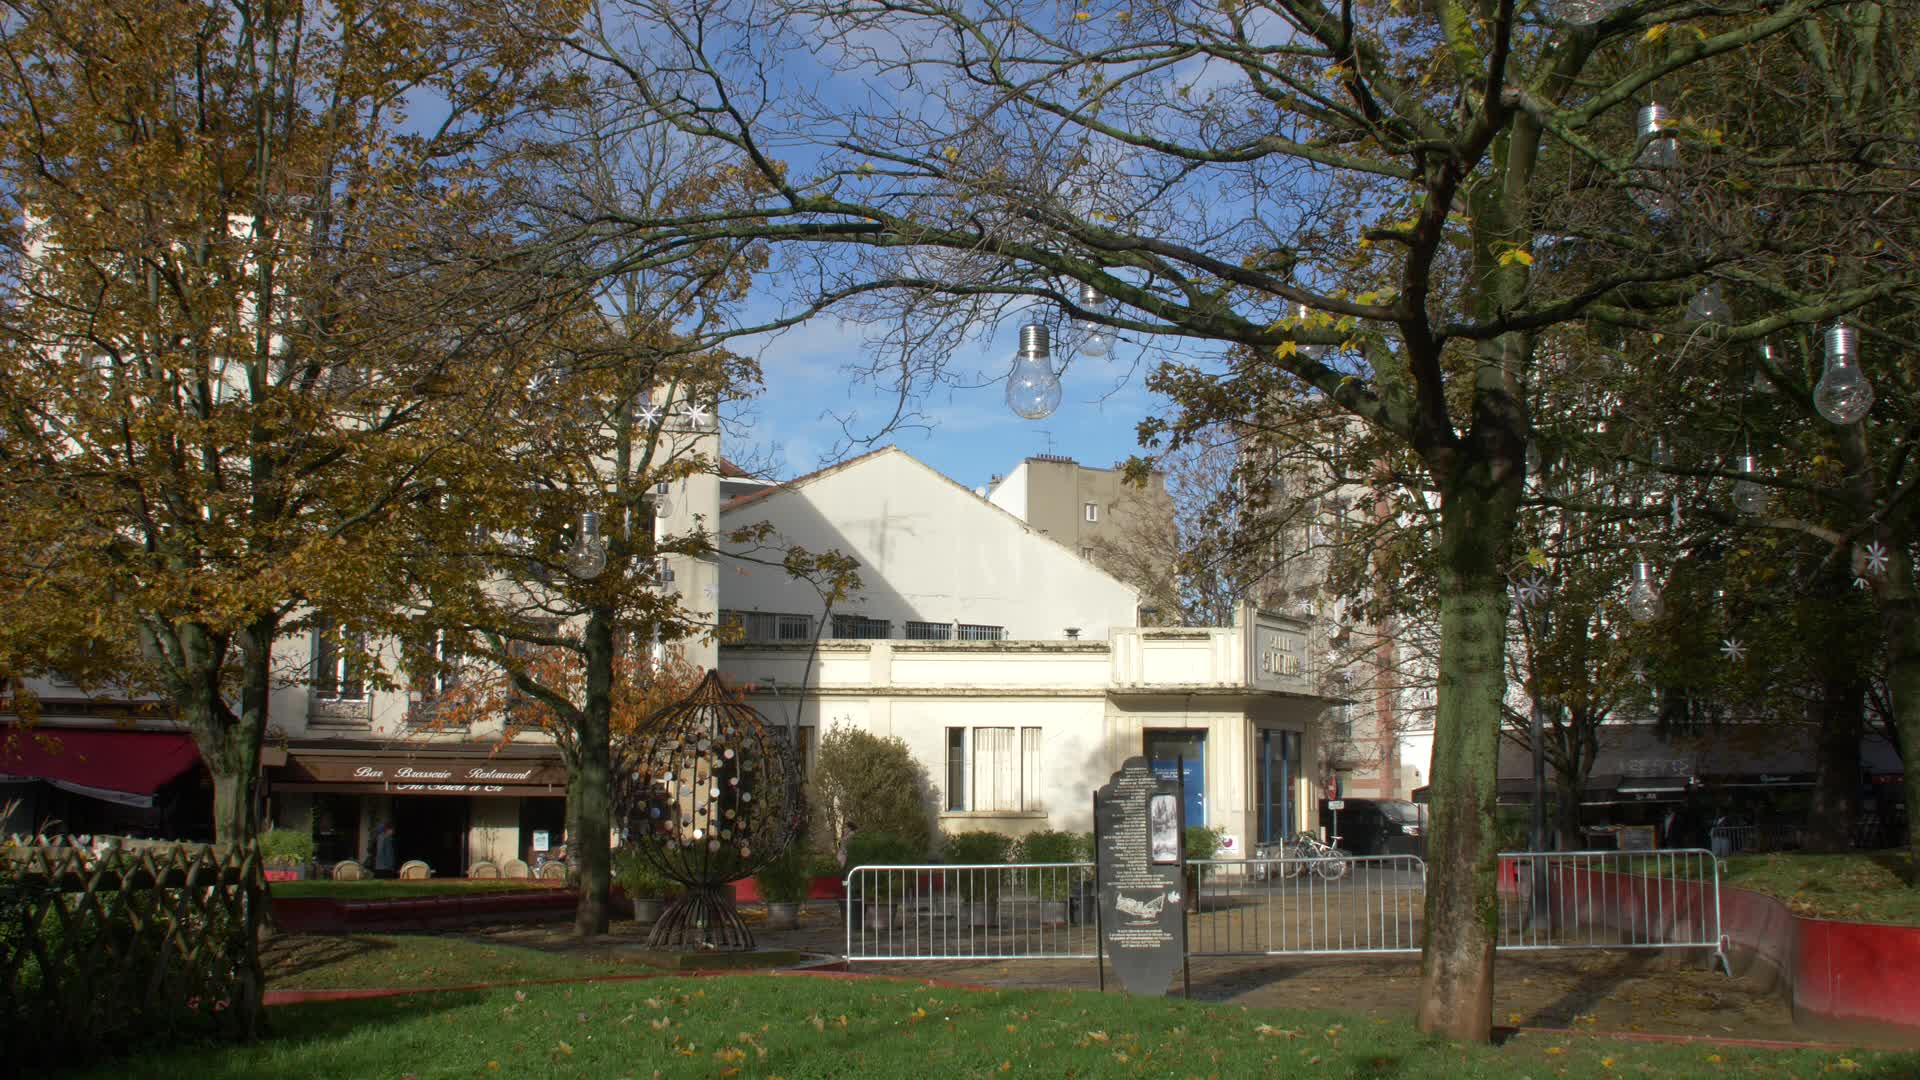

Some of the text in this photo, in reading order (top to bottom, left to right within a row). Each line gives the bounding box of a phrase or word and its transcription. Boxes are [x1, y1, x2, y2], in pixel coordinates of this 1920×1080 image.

[353, 767, 532, 779] Bar Brasserie Restaurant
